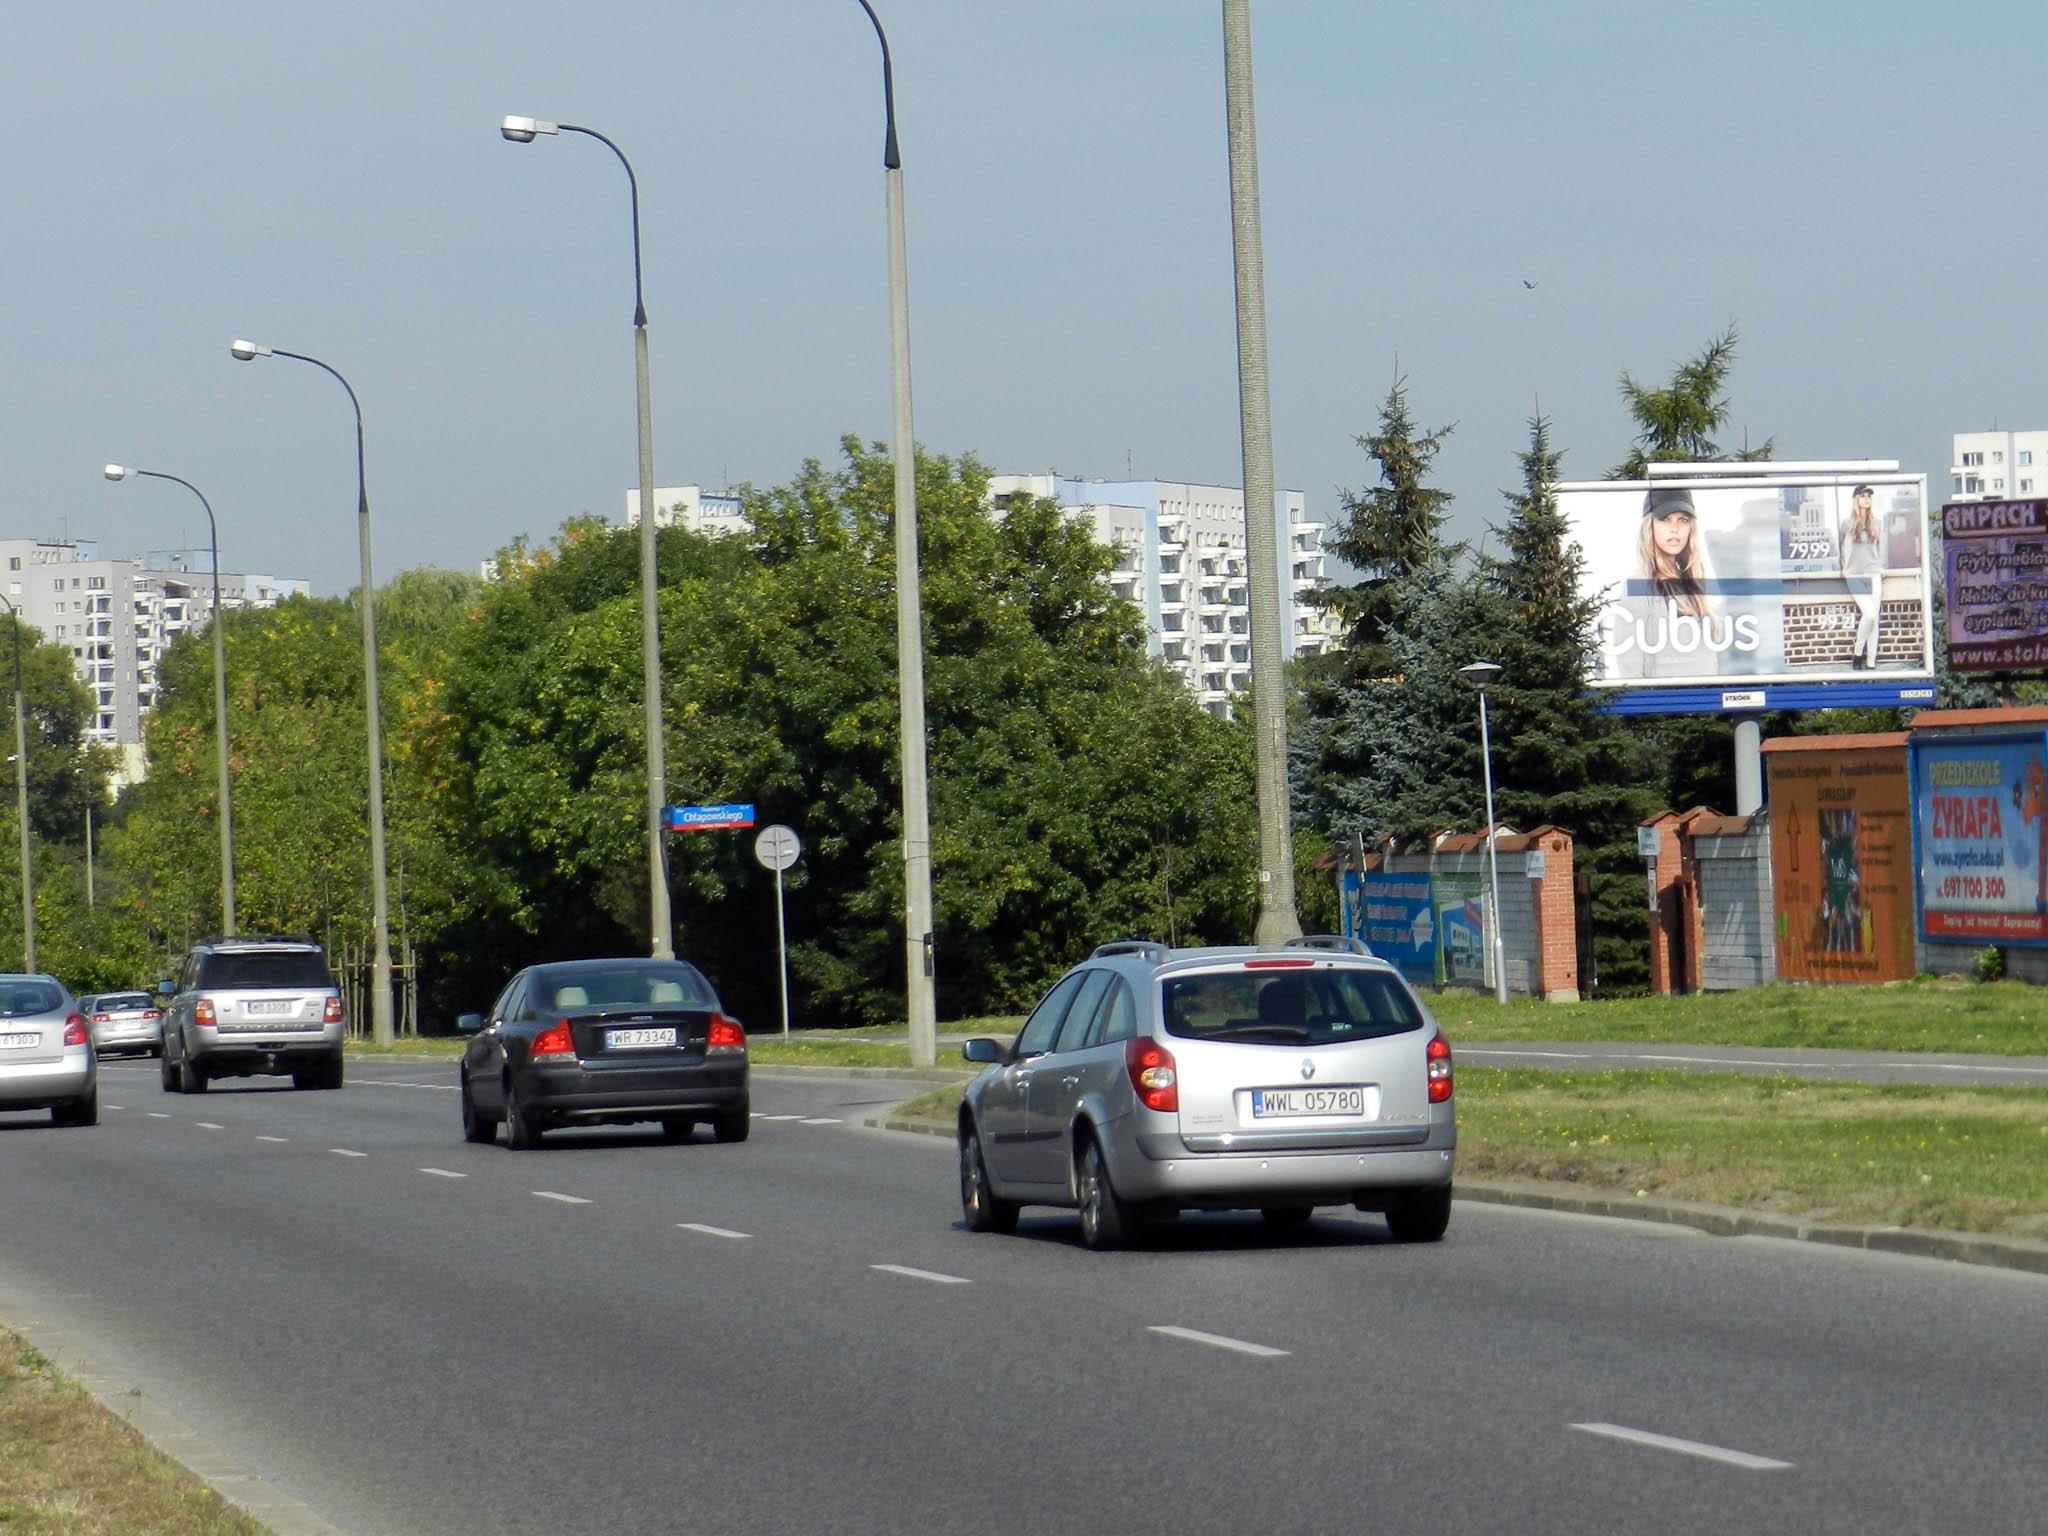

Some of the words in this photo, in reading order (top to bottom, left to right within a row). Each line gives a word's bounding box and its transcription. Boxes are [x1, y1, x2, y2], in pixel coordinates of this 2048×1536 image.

[1789, 542, 1830, 559] 79,99
[1600, 598, 1760, 656] Cubus
[615, 1032, 631, 1043] WR
[637, 1030, 674, 1042] 73342
[1264, 1093, 1298, 1112] WWL
[1305, 1091, 1360, 1110] 05780
